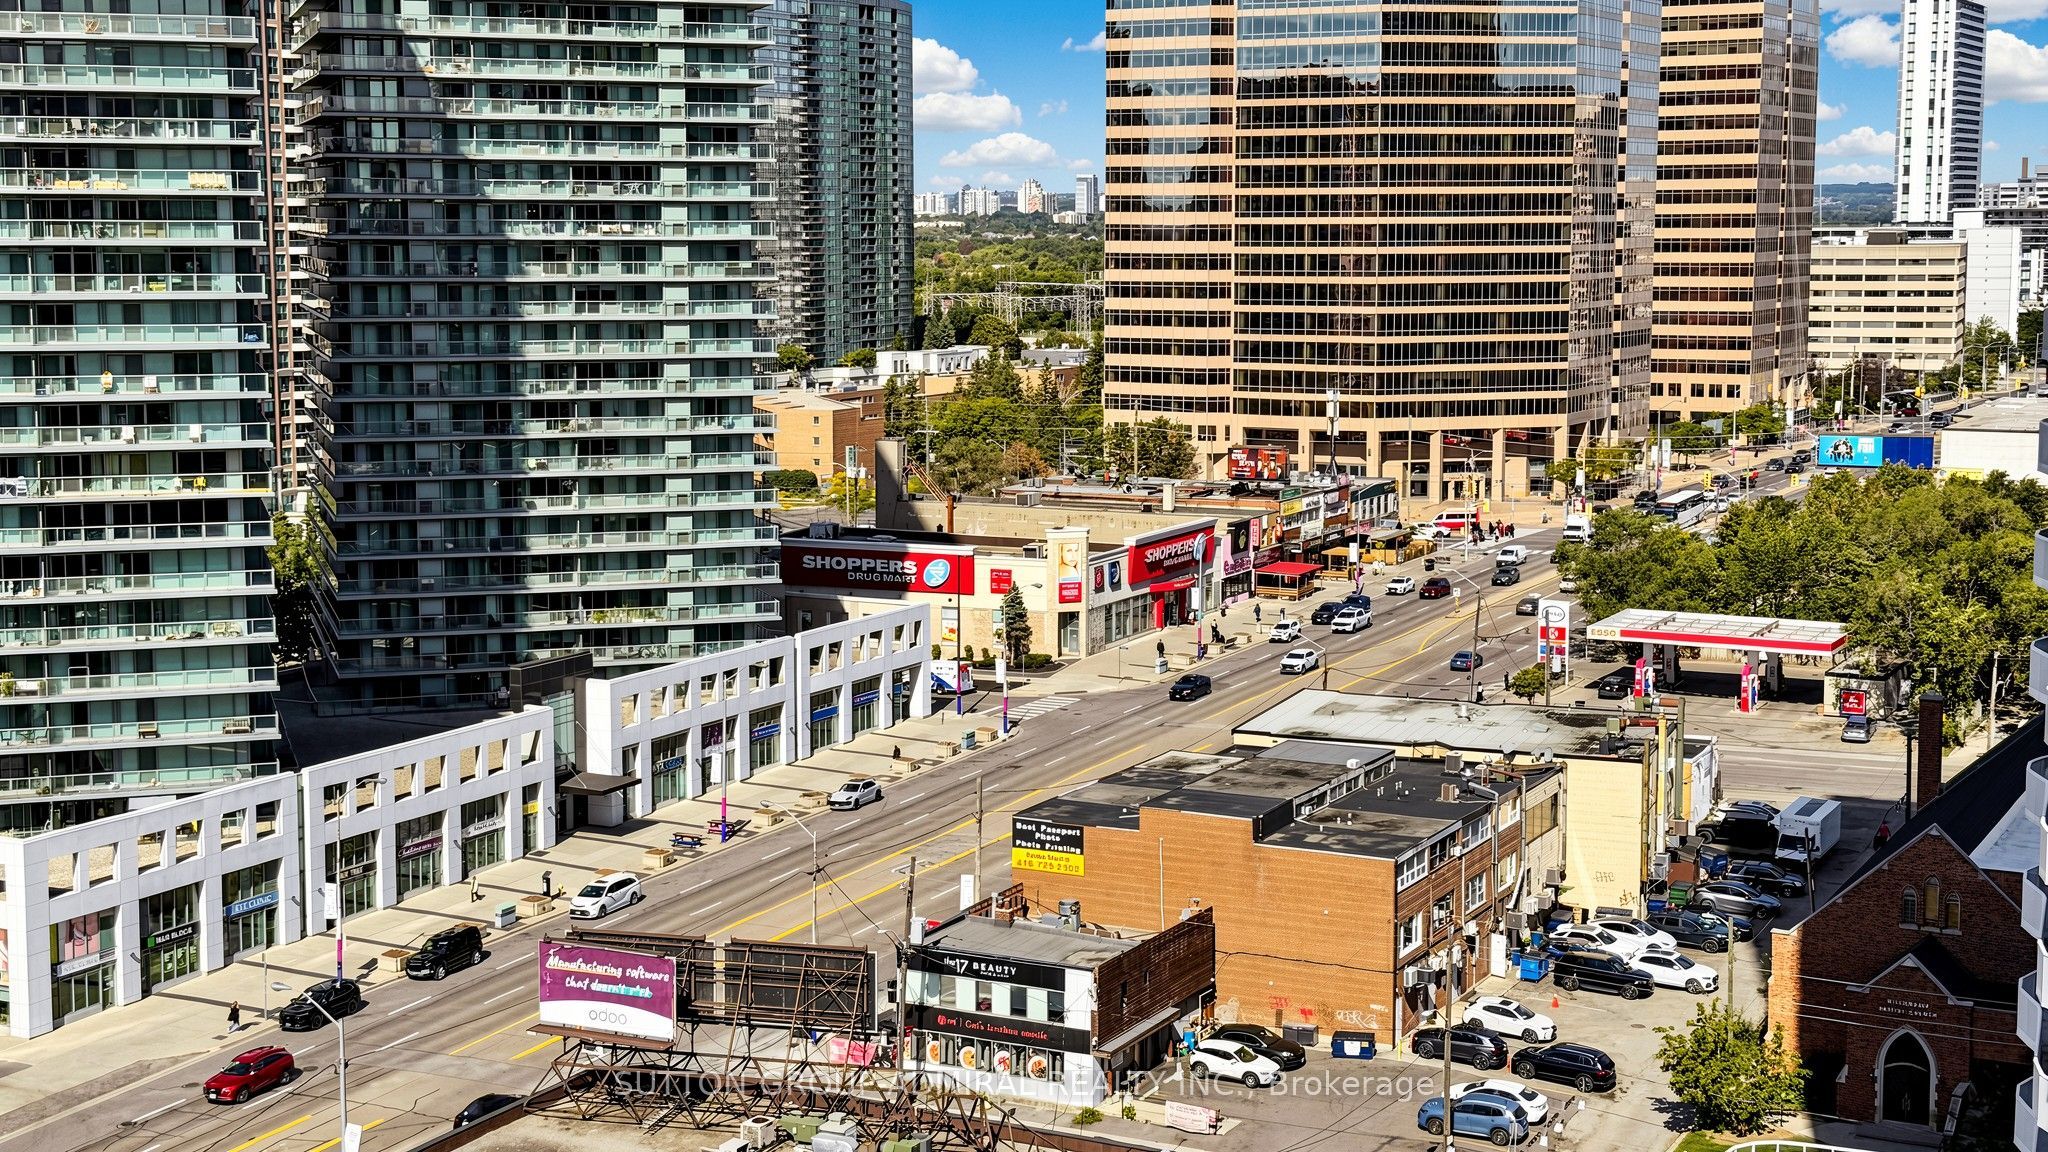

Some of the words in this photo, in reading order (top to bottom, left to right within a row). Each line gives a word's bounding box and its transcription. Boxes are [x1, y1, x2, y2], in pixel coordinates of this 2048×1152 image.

[1144, 538, 1196, 563] SHOPPERS
[803, 555, 917, 574] SHOPPERS
[848, 572, 881, 582] DRUG
[883, 574, 917, 584] MART
[1034, 832, 1061, 842] Photo
[1040, 825, 1081, 836] Passport
[1015, 840, 1041, 849] Photo
[1045, 843, 1081, 855] Printing
[171, 927, 193, 939] BLOCK
[545, 956, 623, 978] Manufacturing
[626, 965, 670, 983] software
[955, 959, 969, 974] 17
[972, 962, 1017, 975] BEAUTY
[565, 976, 589, 990] that
[588, 1008, 628, 1025] odoo
